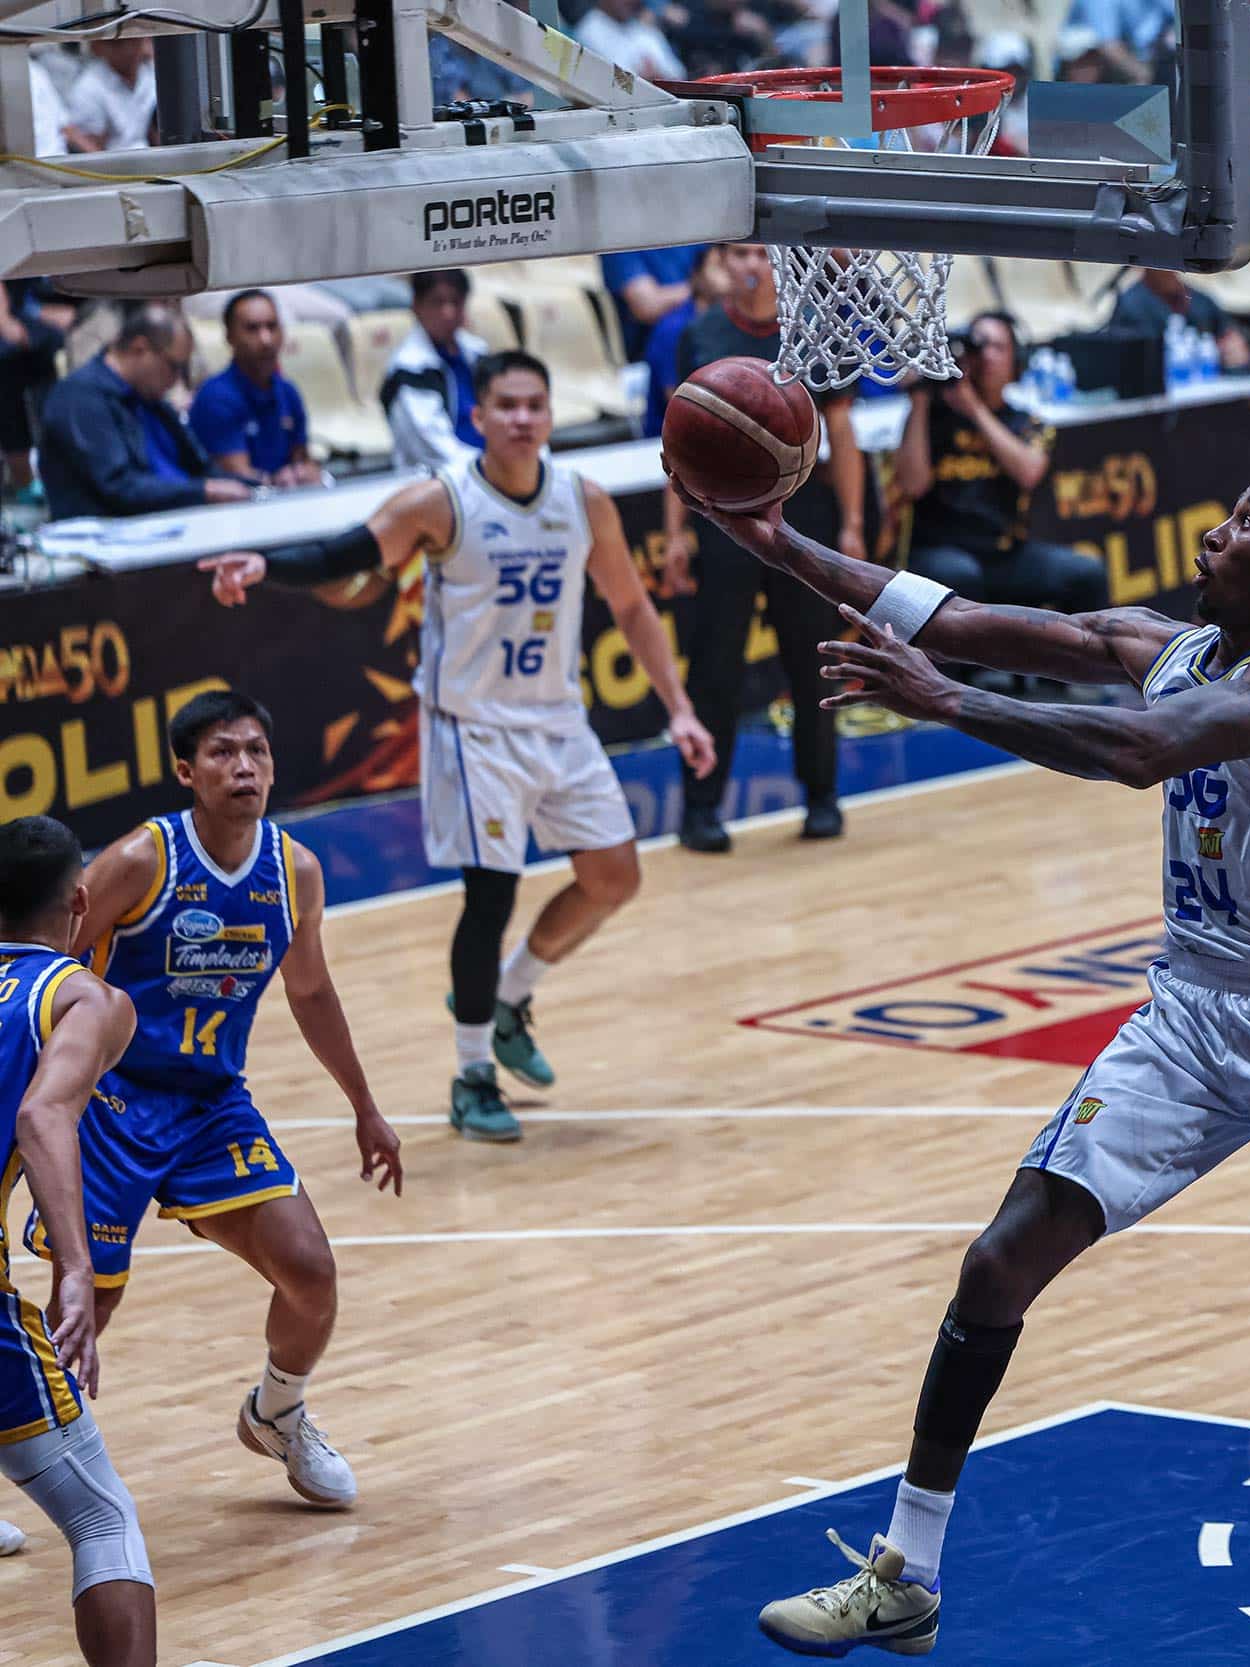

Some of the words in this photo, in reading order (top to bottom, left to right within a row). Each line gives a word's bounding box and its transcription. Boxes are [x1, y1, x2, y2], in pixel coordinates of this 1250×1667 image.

[449, 238, 472, 250] What
[473, 235, 487, 248] the
[496, 563, 565, 605] 5G
[501, 637, 546, 678] 16
[1169, 860, 1239, 926] 24
[175, 943, 260, 970] Timplados
[180, 1007, 226, 1056] 14
[227, 1137, 279, 1177] 14
[92, 1222, 128, 1235] GAME
[92, 1232, 128, 1245] VILLE
